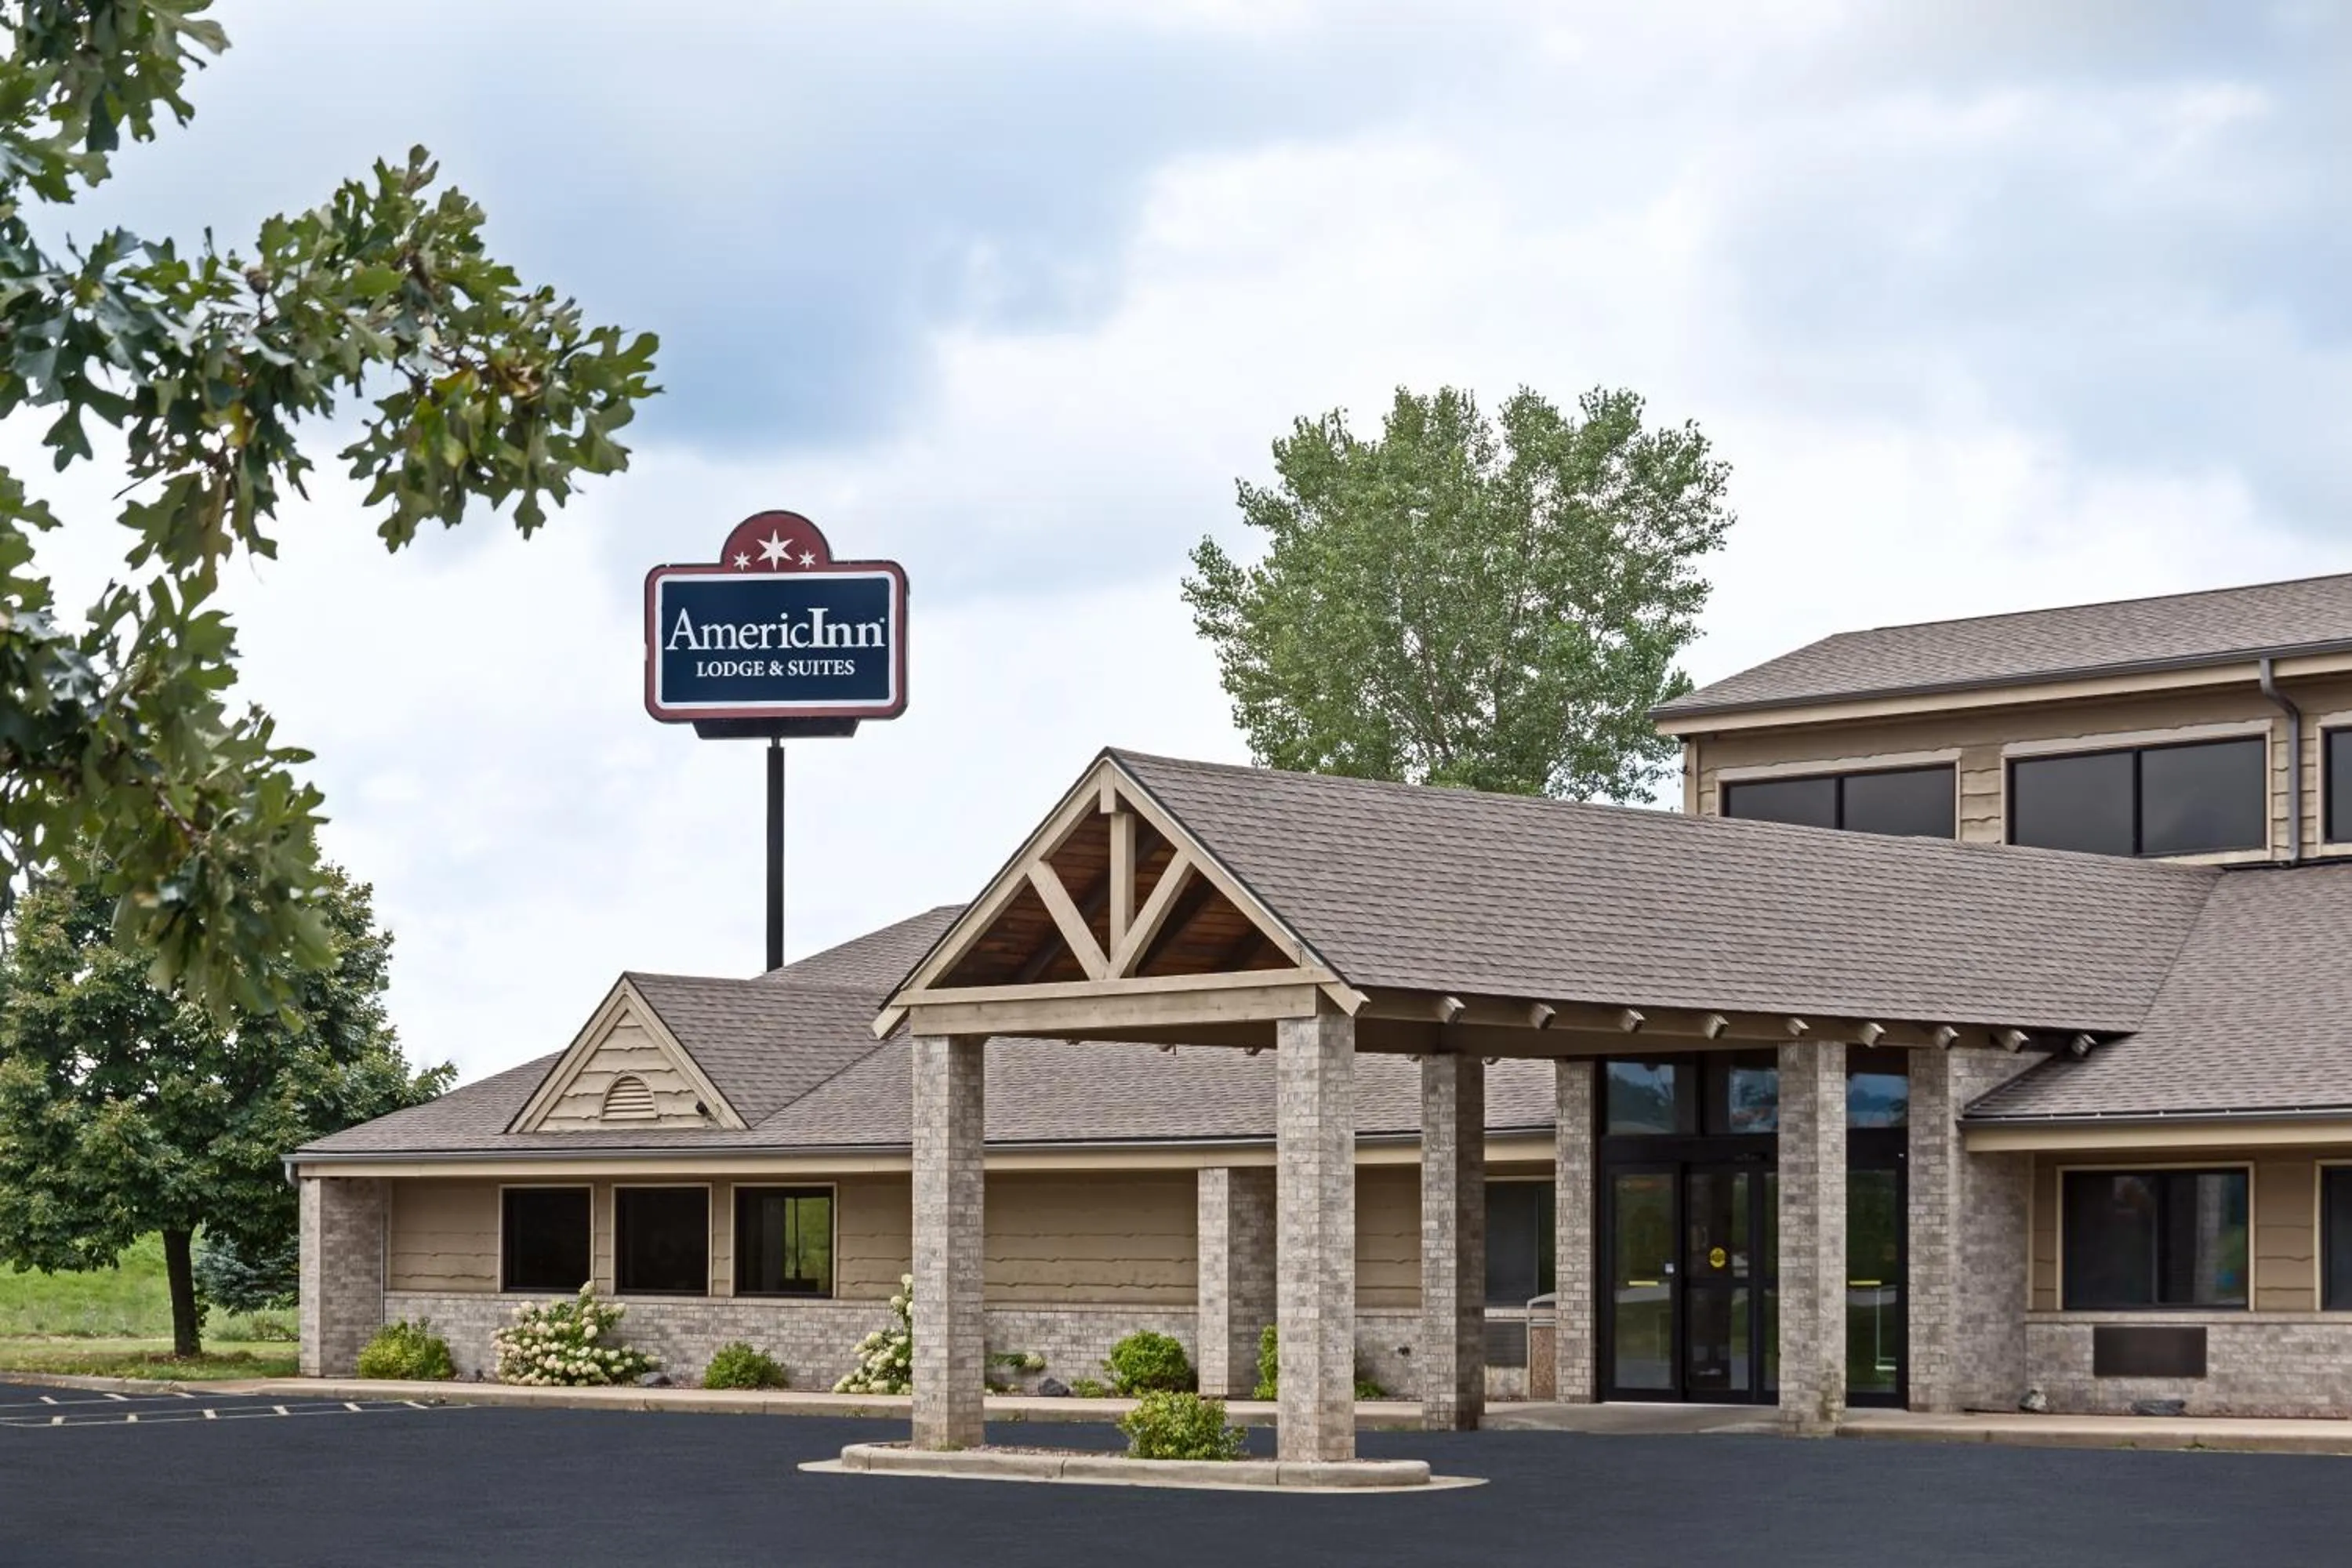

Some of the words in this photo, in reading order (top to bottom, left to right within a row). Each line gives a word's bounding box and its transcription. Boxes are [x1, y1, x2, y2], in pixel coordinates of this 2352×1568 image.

[665, 607, 886, 651] AmericInn
[696, 661, 764, 677] LODGE
[768, 661, 784, 677] &
[788, 659, 855, 676] SUITES
